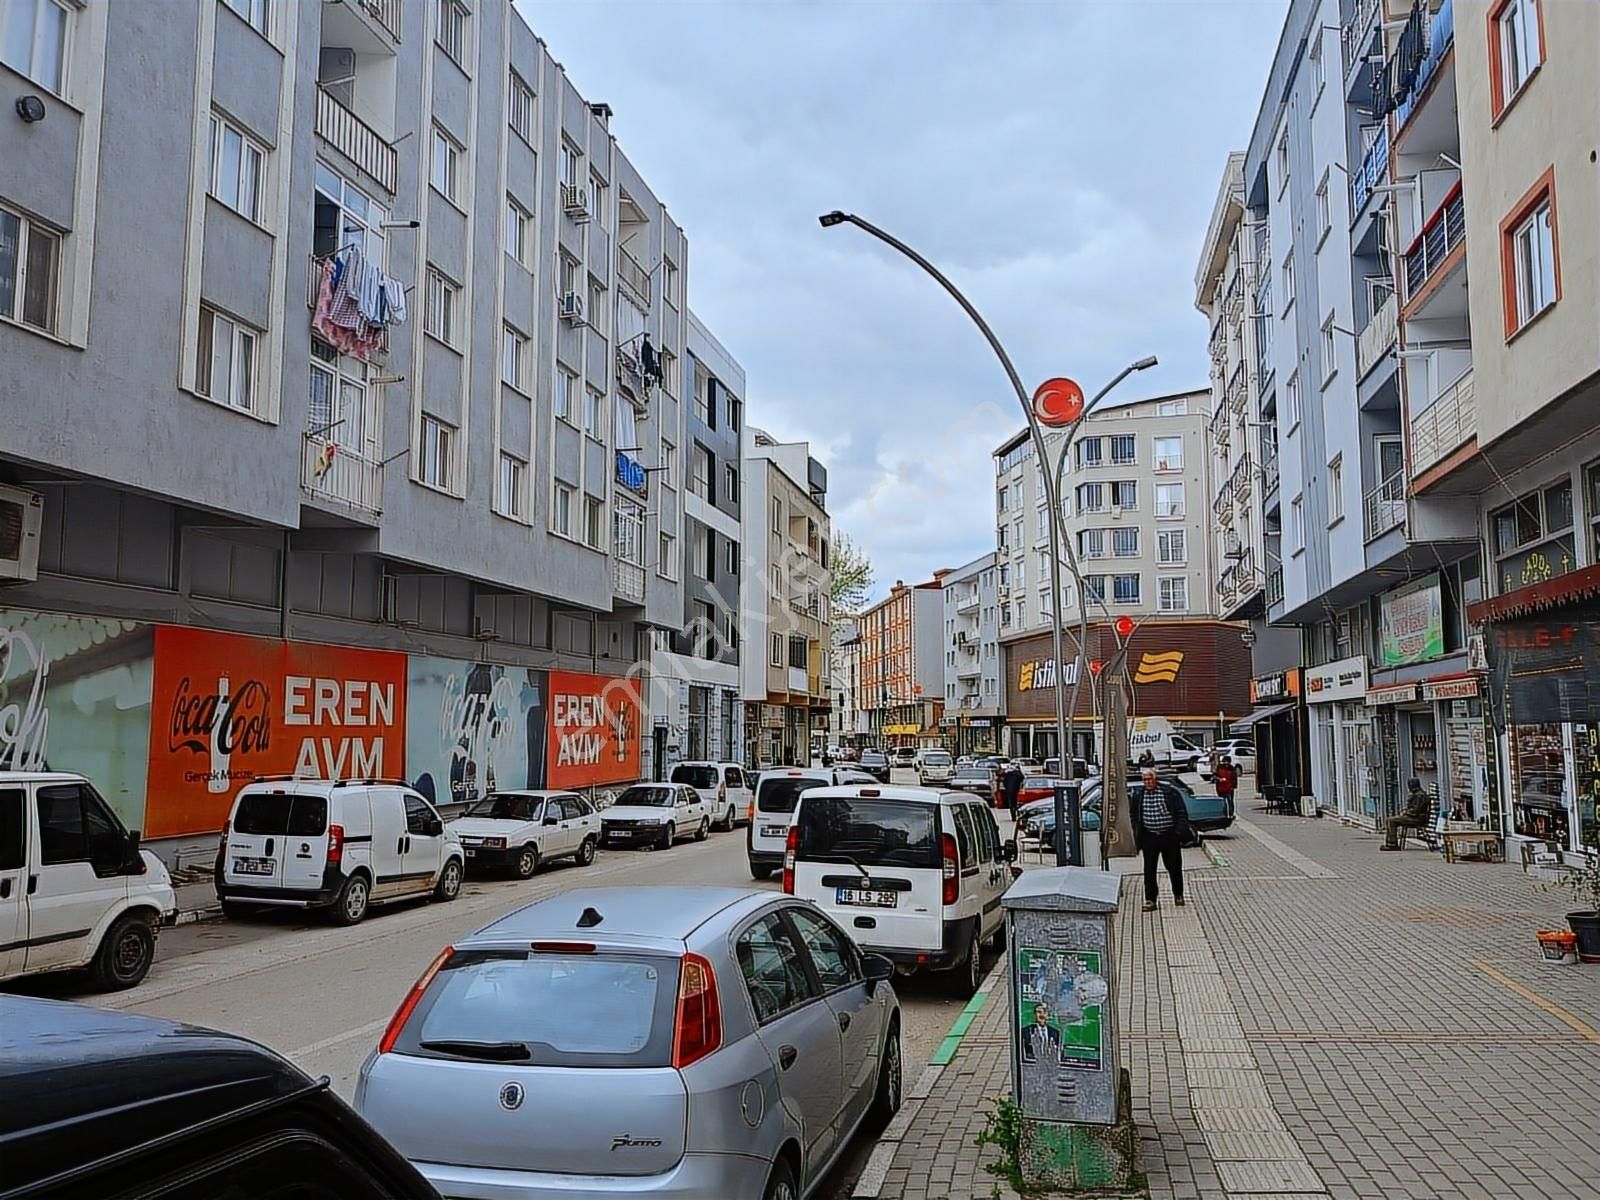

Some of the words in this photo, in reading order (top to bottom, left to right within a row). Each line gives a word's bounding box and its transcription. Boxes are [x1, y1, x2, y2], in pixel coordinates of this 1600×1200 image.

[283, 675, 394, 726] EREN
[553, 694, 604, 727] EREN
[293, 737, 384, 780] AVM
[557, 733, 601, 767] AVM
[184, 769, 219, 783] Gerçek
[859, 891, 872, 902] LS
